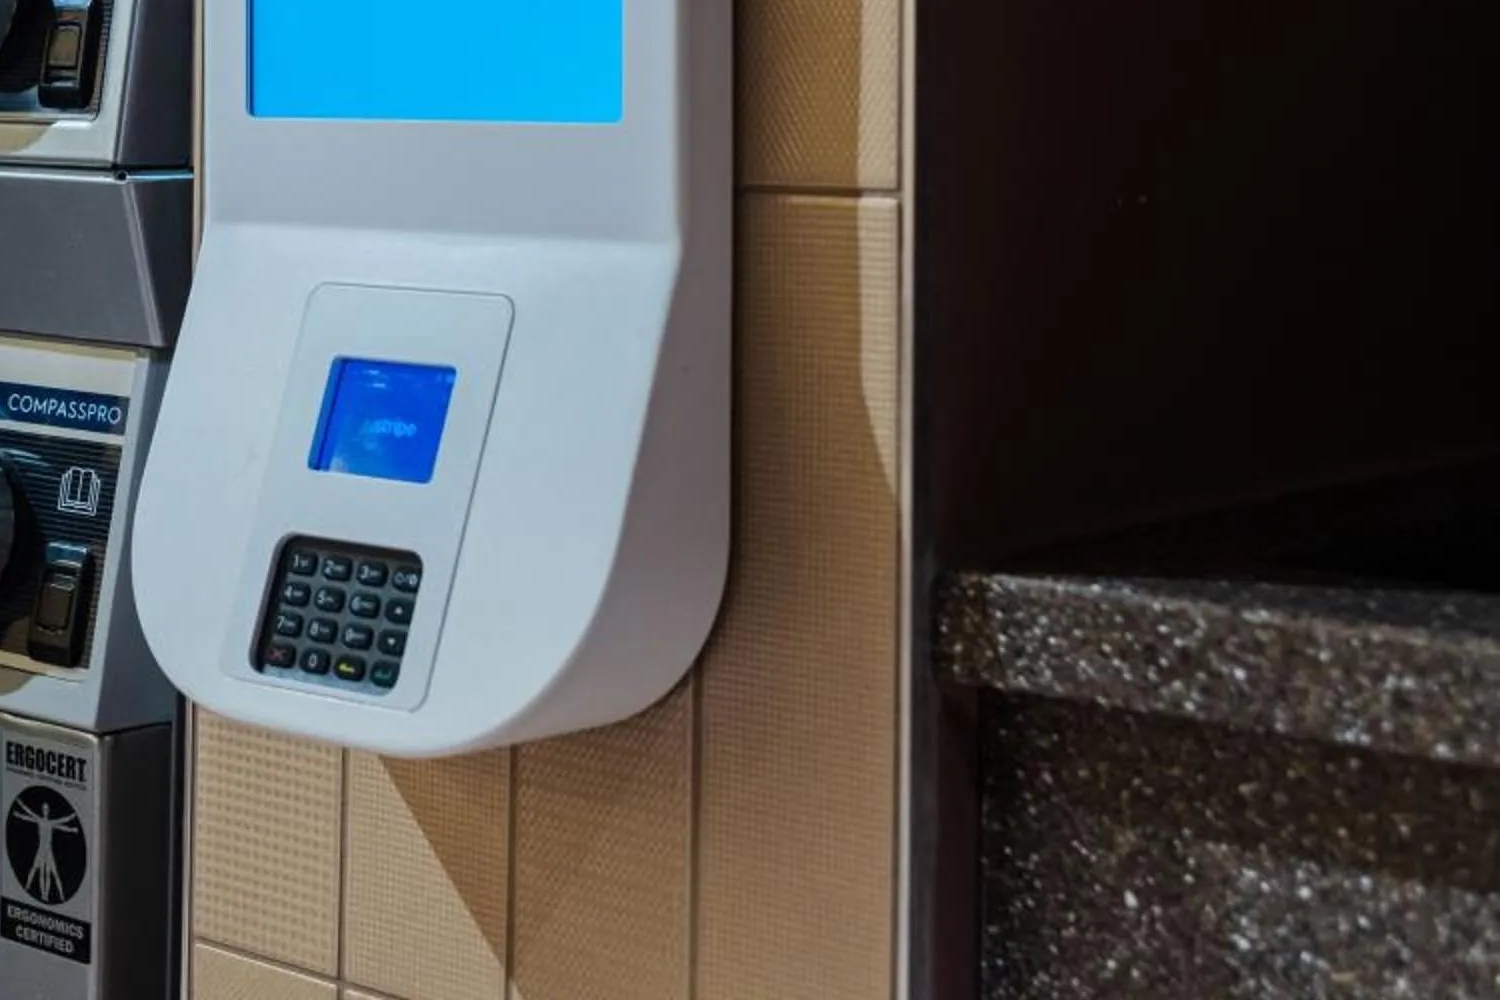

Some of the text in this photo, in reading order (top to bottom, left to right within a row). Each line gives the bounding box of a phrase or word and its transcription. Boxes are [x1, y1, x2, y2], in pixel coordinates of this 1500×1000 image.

[7, 393, 122, 425] COMPASSPRO
[6, 740, 87, 782] ERGOCERT
[6, 904, 84, 939] ERGONOMICS
[15, 924, 74, 954] CERTIFIED
